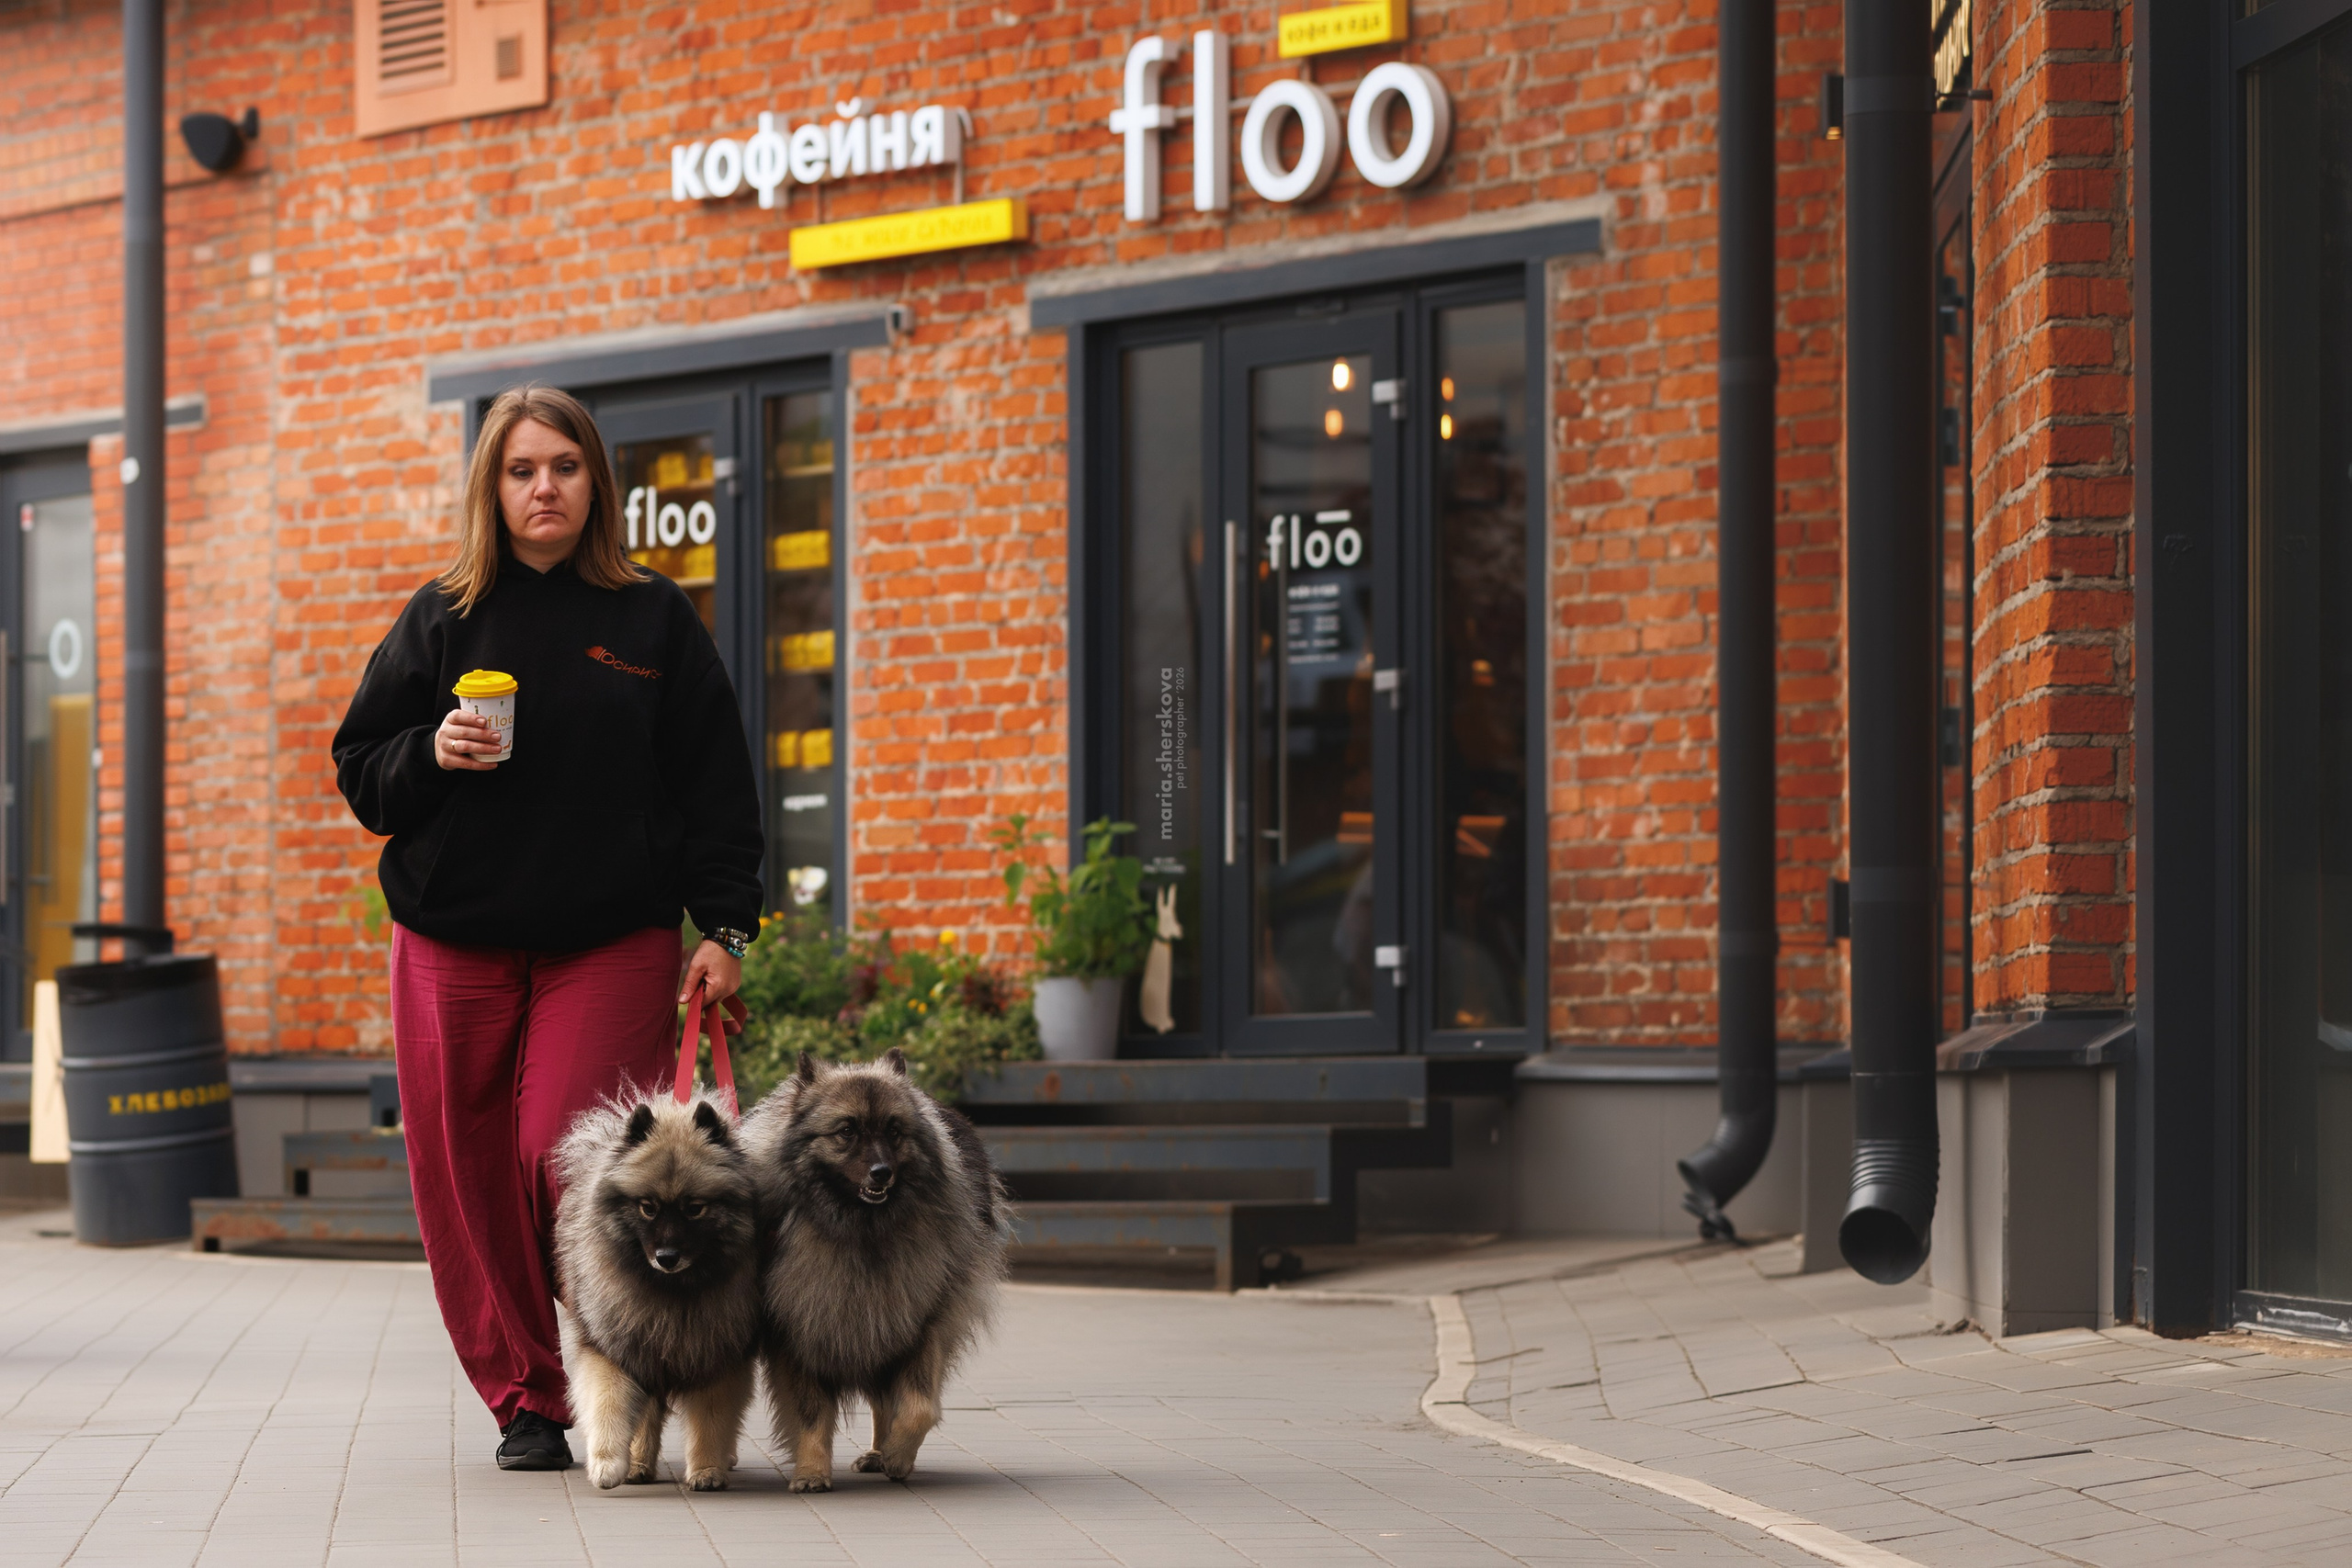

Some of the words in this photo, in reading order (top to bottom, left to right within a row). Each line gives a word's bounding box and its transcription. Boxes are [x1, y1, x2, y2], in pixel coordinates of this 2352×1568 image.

[671, 96, 946, 209] кофейня
[1109, 29, 1439, 222] floo
[625, 485, 717, 549] floo
